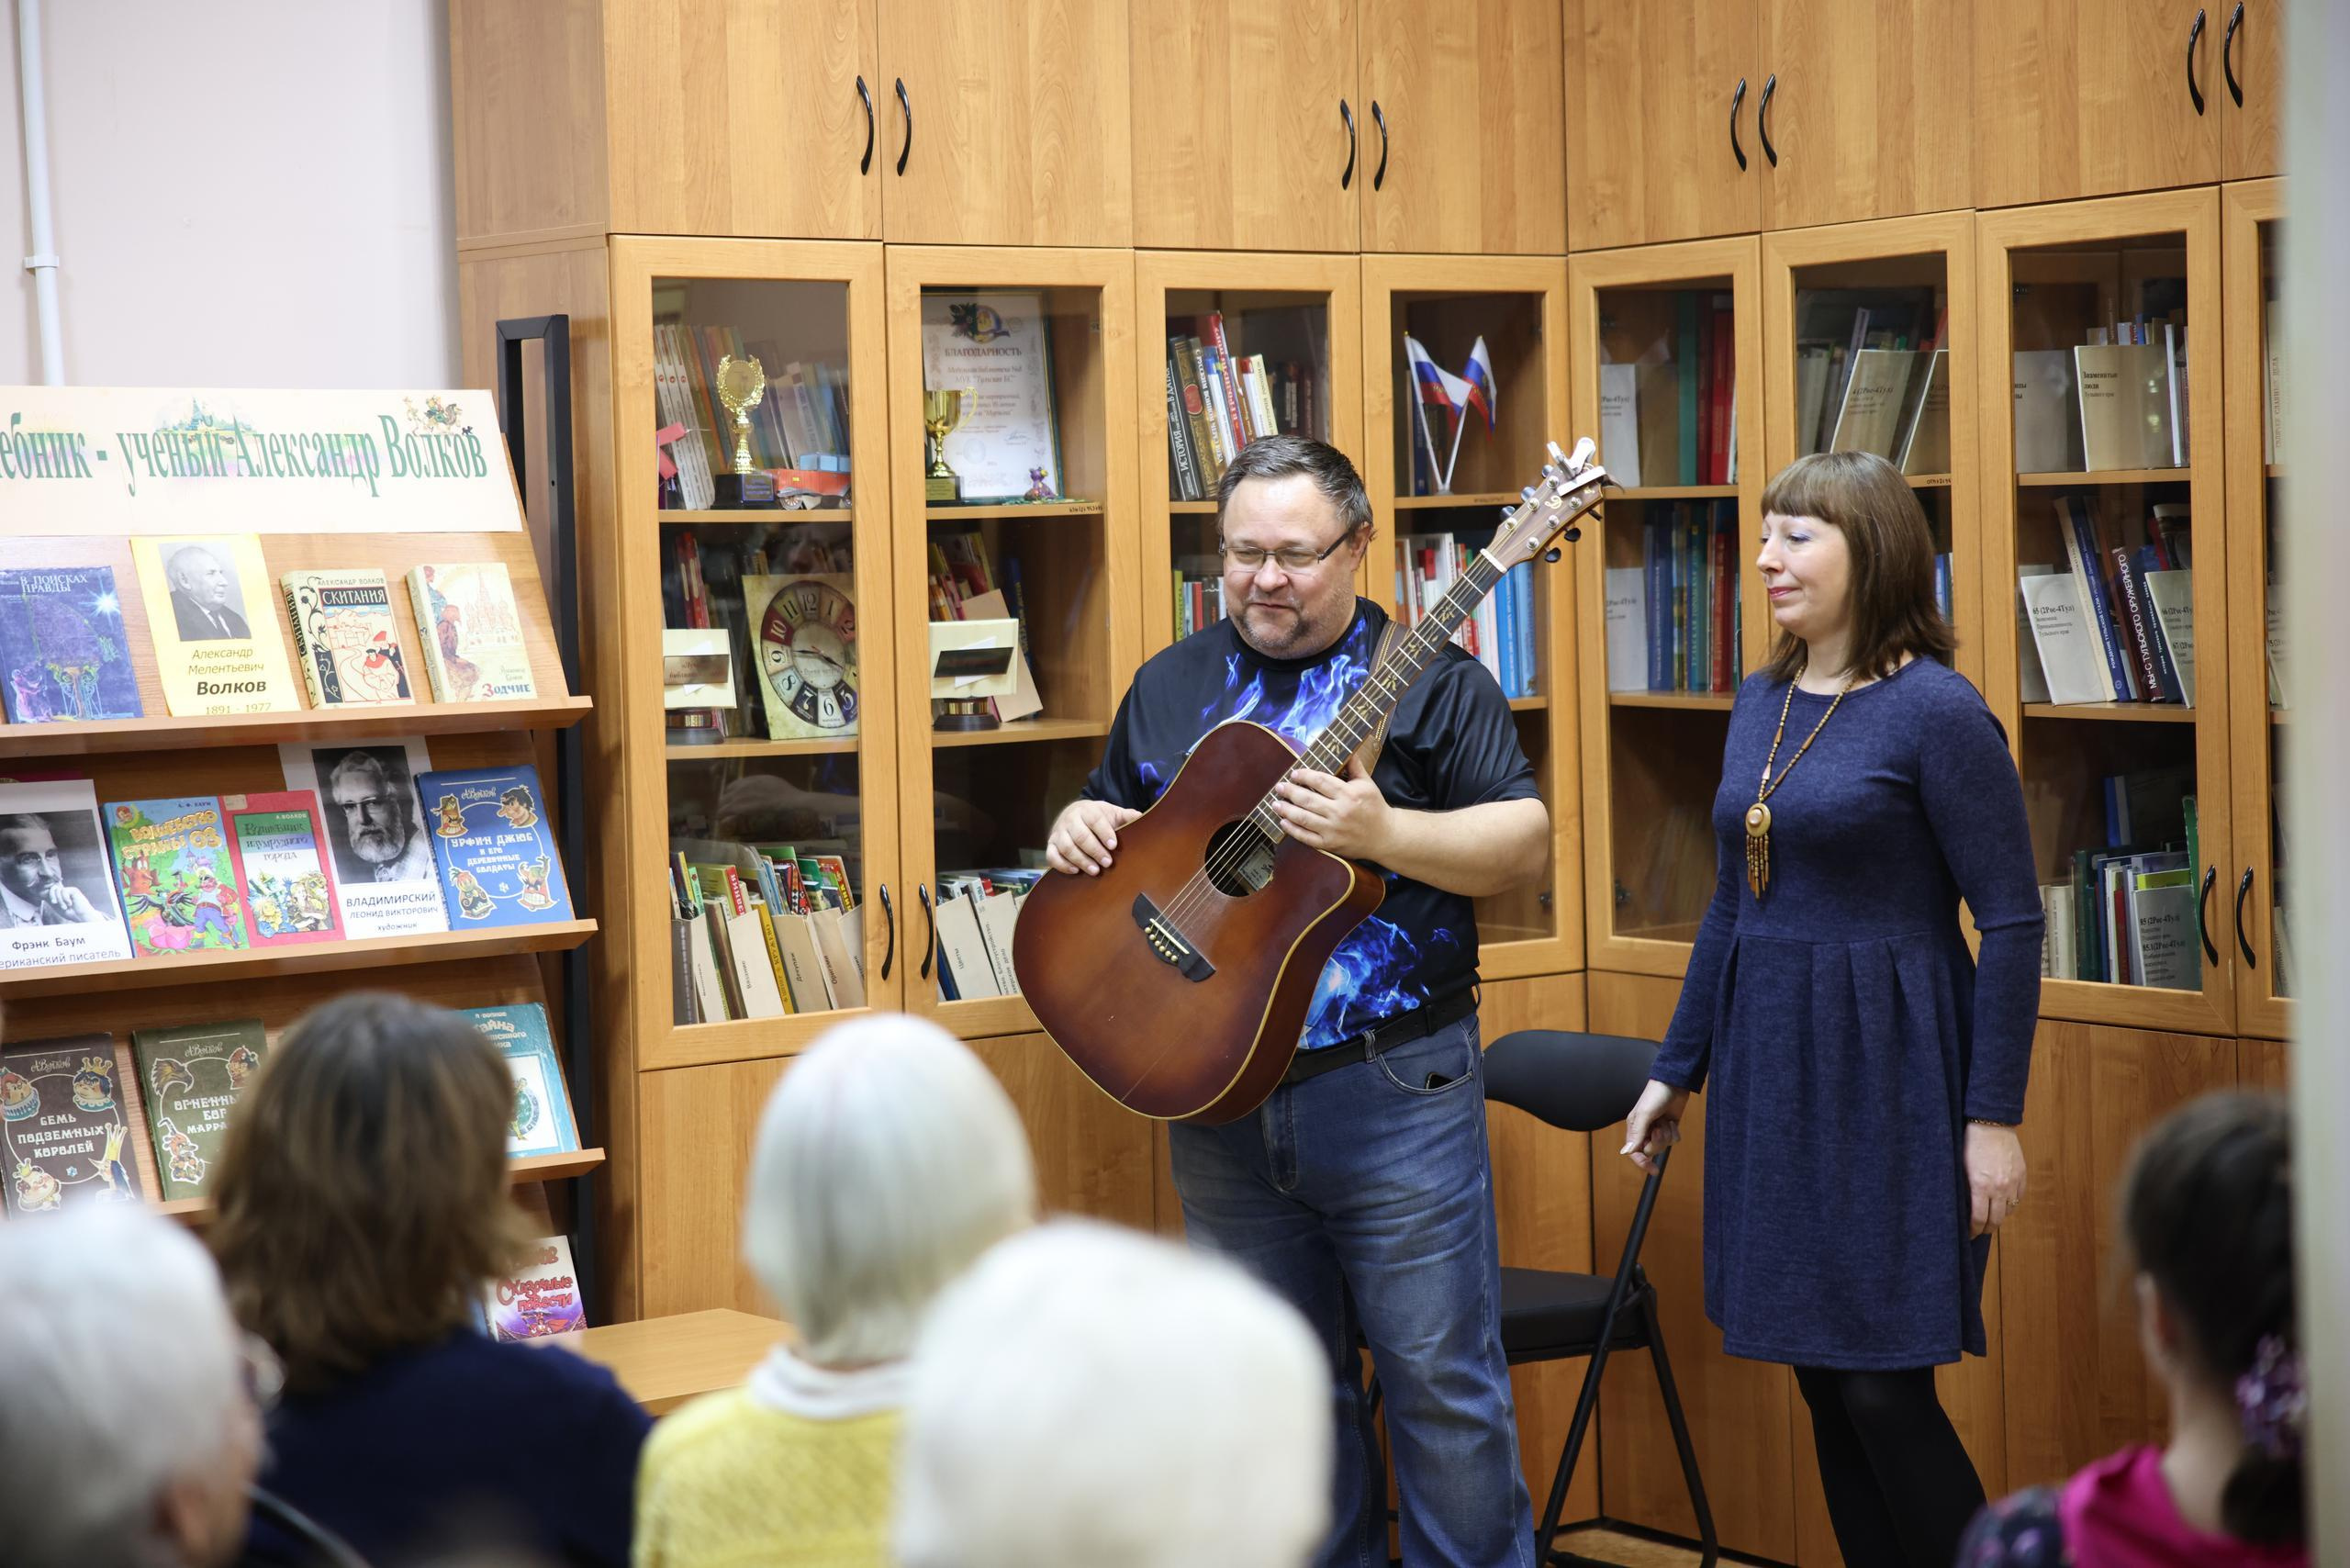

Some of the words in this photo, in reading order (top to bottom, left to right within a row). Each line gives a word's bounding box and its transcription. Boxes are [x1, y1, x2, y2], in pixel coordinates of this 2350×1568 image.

[945, 348, 1022, 356] БЛАГОДАРНОСТЬ
[0, 411, 93, 479] ебник
[233, 414, 380, 497] Александр
[377, 415, 487, 479] Волков
[1173, 430, 1189, 472] ИСТОРИЯ
[20, 576, 28, 586] В
[34, 574, 88, 586] ПОИСКАХ
[22, 583, 71, 593] ПРАВДЫ
[2118, 554, 2139, 612] ОРУЖЕЙНОГО
[322, 589, 386, 605] СКИТАНИЯ
[803, 593, 817, 611] 12
[783, 600, 799, 620] 11
[828, 600, 834, 617] 1
[770, 620, 788, 640] 10
[2132, 614, 2150, 661] ТУЛЬСКОГО
[193, 648, 253, 660] Александр
[771, 650, 787, 664] 9
[188, 664, 264, 676] Мелентьевич
[196, 681, 266, 695] Волков
[782, 675, 797, 691] 8
[206, 705, 230, 715] 1891
[246, 702, 272, 712] 1977
[801, 690, 814, 711] 7
[823, 697, 834, 716] 6
[451, 836, 493, 848] УРФИН
[497, 833, 533, 847] ДЖЮС
[476, 864, 515, 874] СОЛДАТЫ
[346, 891, 436, 907] ВЛАДИМИРСКИЙ
[350, 911, 384, 919] ЛЕОНИД
[386, 907, 438, 917] ВИКТОРОВИЧ
[12, 941, 50, 953] Фрэнк
[55, 936, 85, 947] Баум
[69, 949, 121, 961] писатель
[824, 955, 837, 985] Оригами
[473, 1019, 515, 1034] айна
[173, 1094, 238, 1111] ОГНЕННЫ
[40, 1114, 77, 1126] СЕМЬ
[17, 1126, 105, 1145] ПОДЗЕМНЫХ
[186, 1122, 229, 1135] МАРРА
[34, 1140, 95, 1158] КОРОЛЕЙ
[518, 1293, 573, 1312] повести
